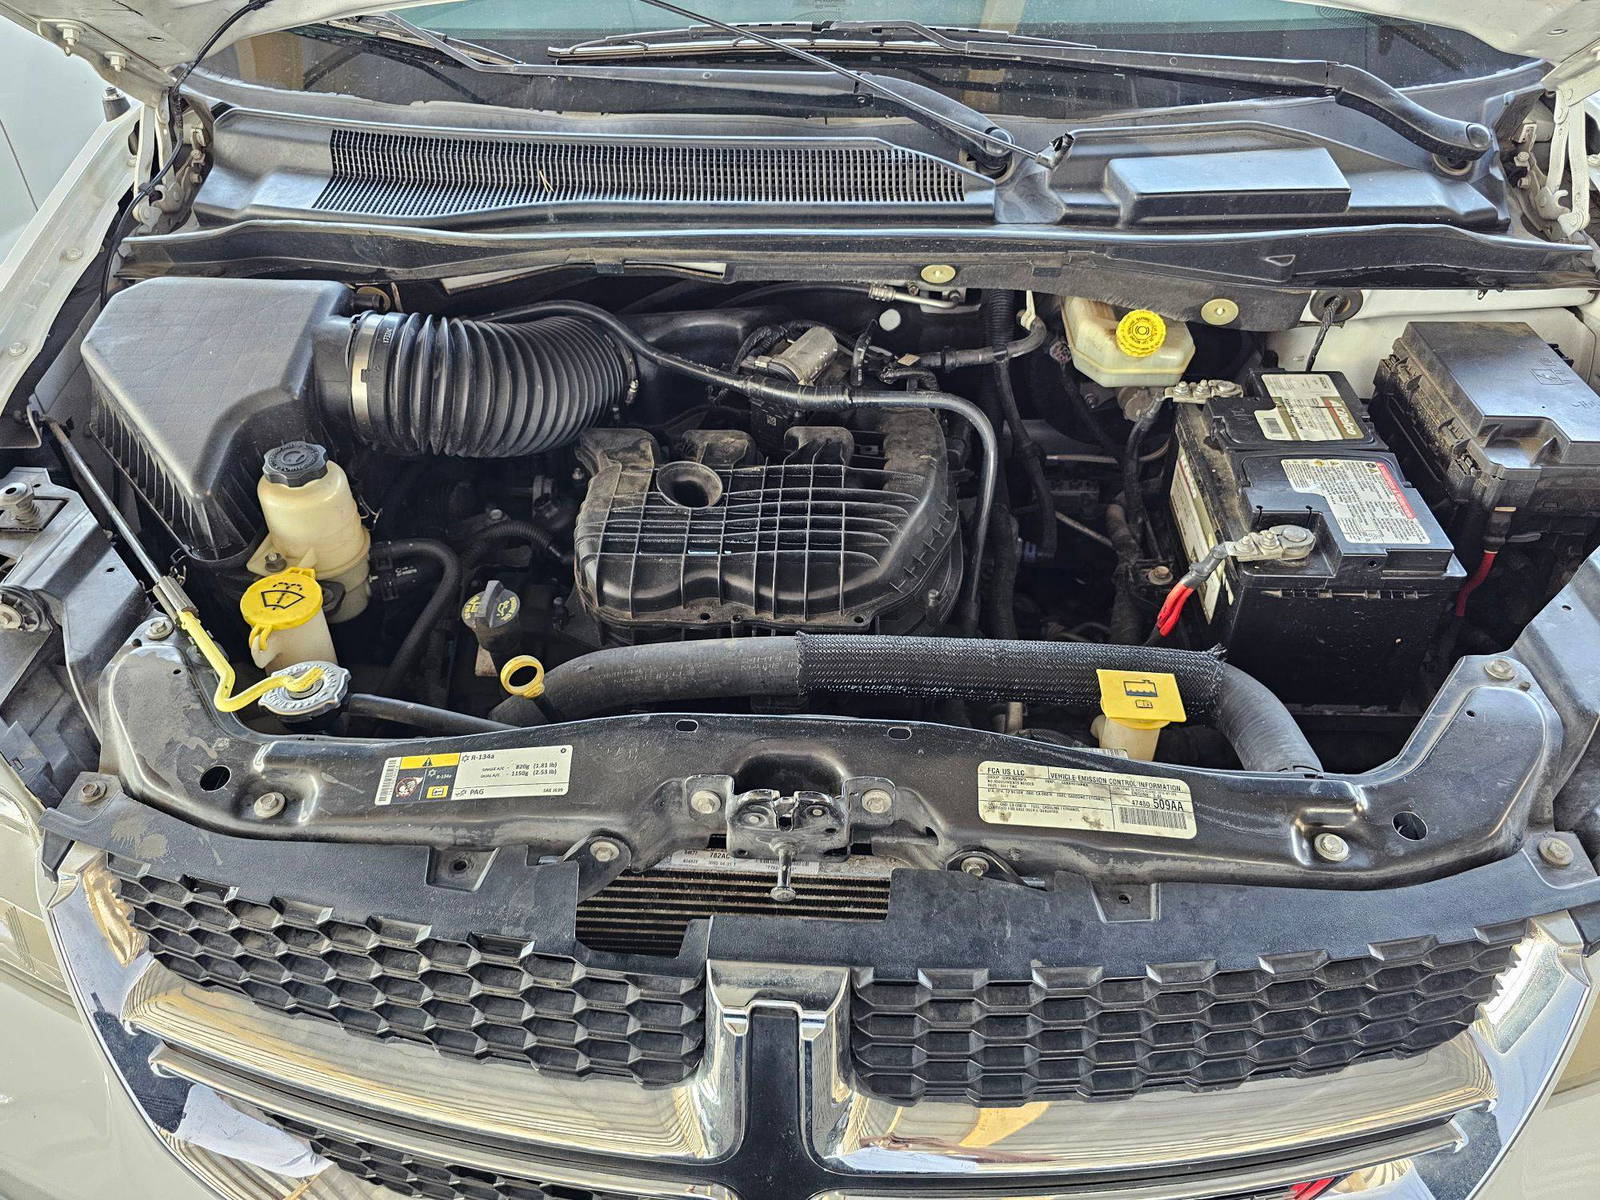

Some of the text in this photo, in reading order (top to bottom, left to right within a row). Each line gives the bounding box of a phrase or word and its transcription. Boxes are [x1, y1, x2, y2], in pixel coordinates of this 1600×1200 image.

[471, 753, 495, 761] R-134a
[533, 762, 548, 770] (1.81
[549, 761, 558, 769] lb)
[1050, 772, 1075, 781] VEHICLE
[1078, 775, 1107, 784] EMISSION
[1108, 777, 1137, 787] CONTROL
[1138, 781, 1181, 792] INFORMATION
[1153, 798, 1184, 811] 509AA
